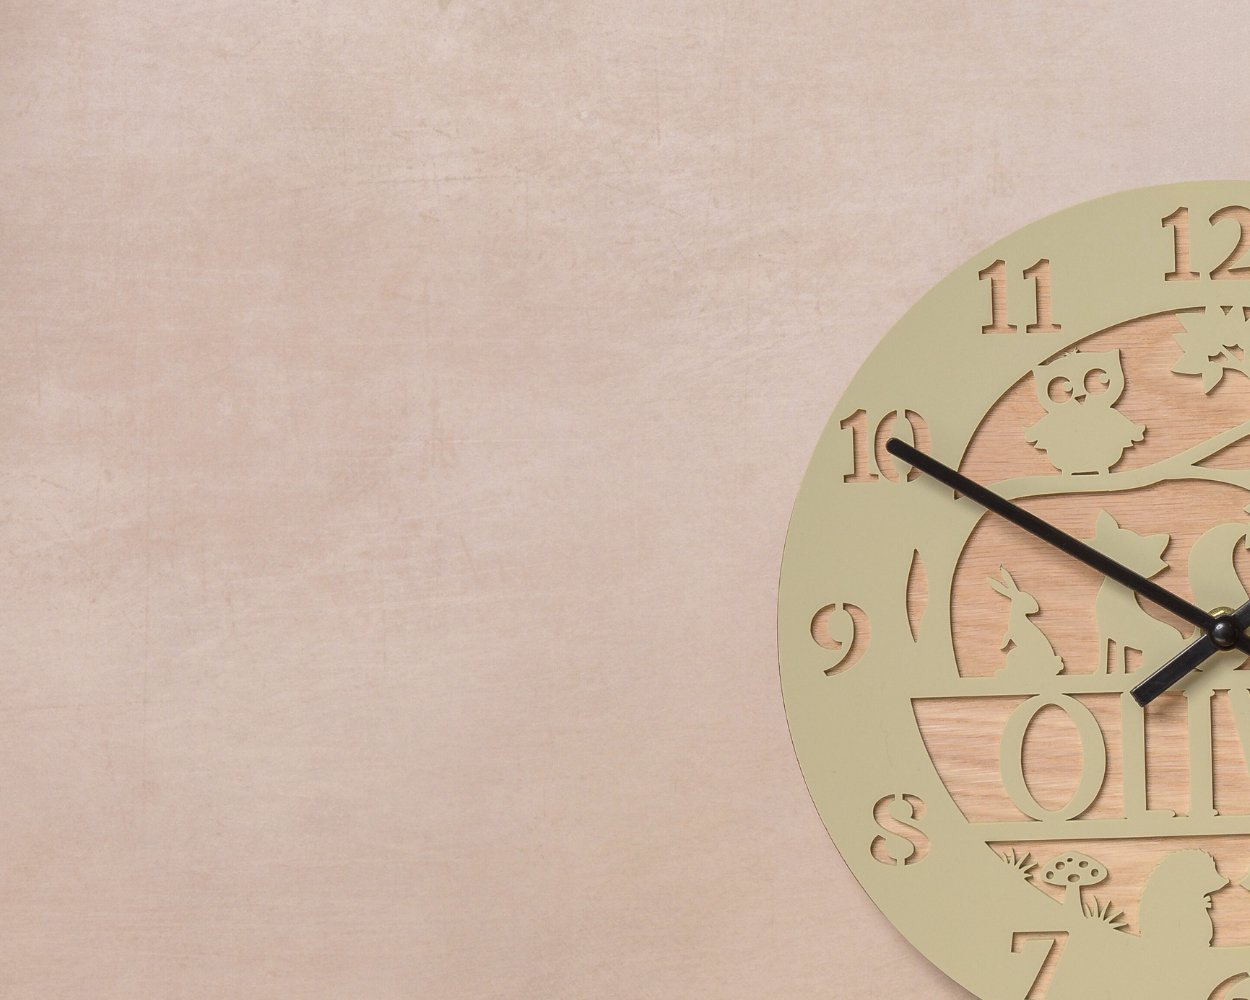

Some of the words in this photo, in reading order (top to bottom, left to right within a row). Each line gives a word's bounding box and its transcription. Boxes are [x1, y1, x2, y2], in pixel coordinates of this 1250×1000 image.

[977, 258, 1062, 335] 11
[839, 408, 932, 484] 10
[809, 602, 872, 677] 9
[869, 793, 932, 867] 8
